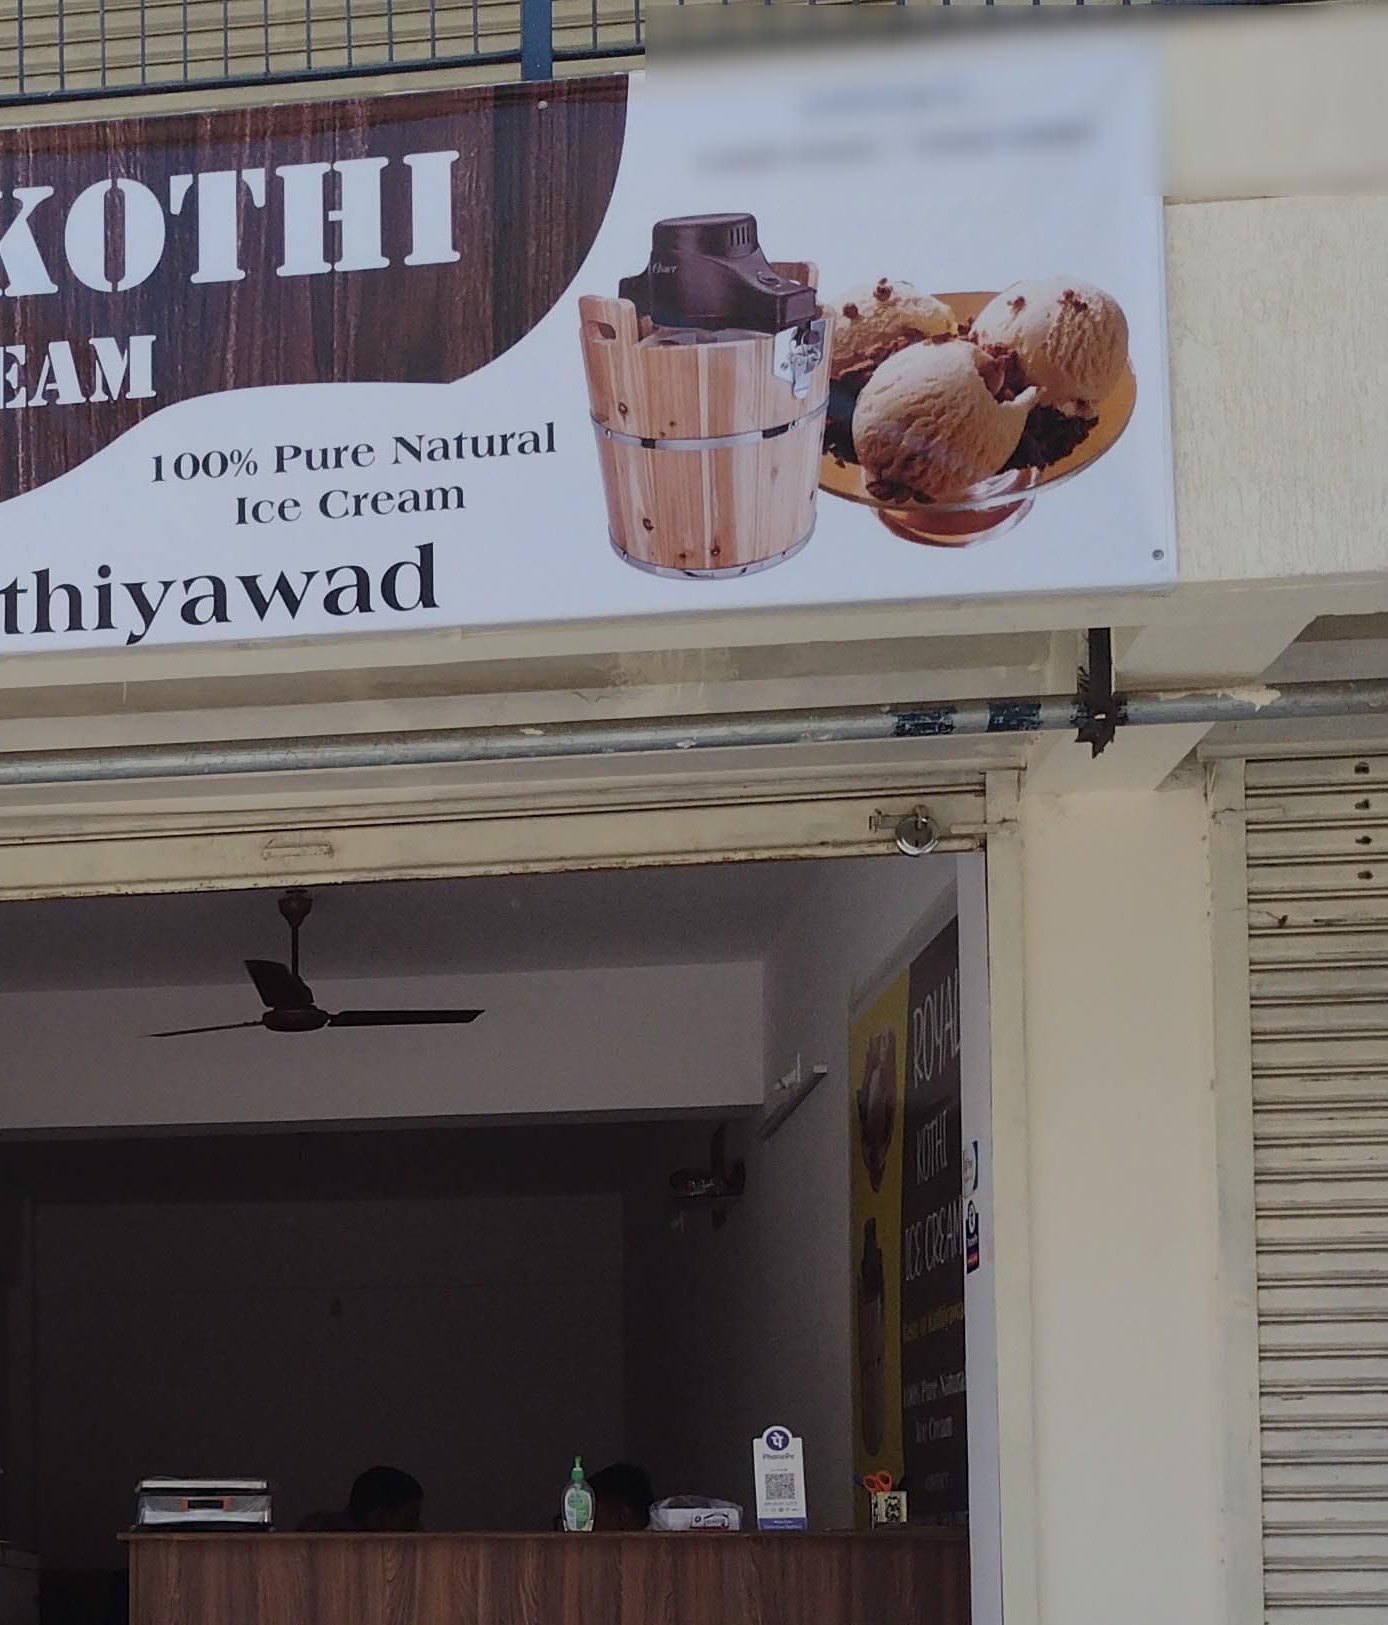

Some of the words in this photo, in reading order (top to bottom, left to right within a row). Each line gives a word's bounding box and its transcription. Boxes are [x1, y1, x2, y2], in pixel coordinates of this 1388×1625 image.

[151, 447, 259, 483] 100%
[274, 437, 375, 474] Pure
[392, 422, 557, 463] Natural
[235, 496, 302, 526] Ice
[319, 484, 466, 520] Cream
[915, 1107, 949, 1186] KOTHI
